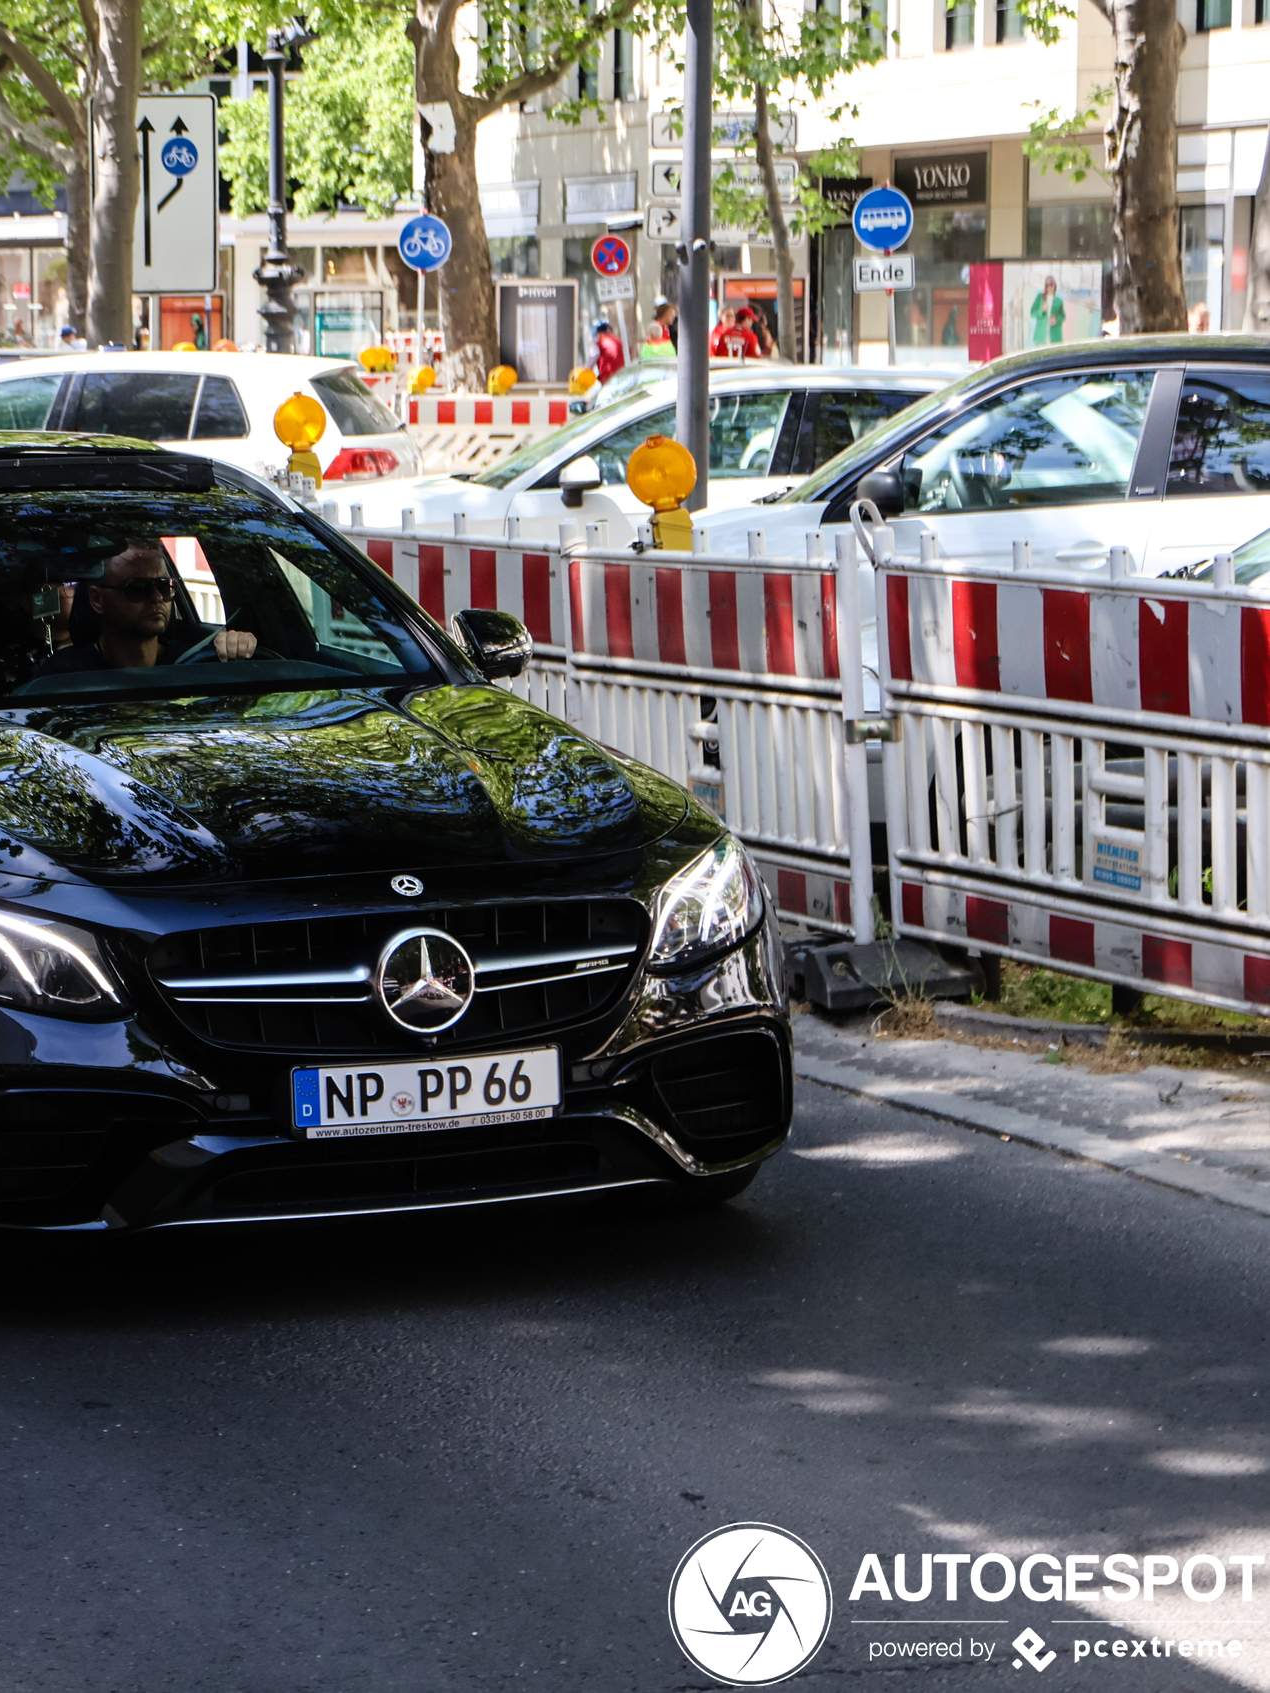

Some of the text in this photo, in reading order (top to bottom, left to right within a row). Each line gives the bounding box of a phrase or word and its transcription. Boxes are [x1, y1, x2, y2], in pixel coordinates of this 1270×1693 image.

[914, 164, 970, 190] YONKO
[859, 263, 904, 282] Ende
[326, 1059, 532, 1119] NP PP 66
[302, 1104, 313, 1117] D
[315, 1119, 460, 1138] www.autozentrum-treskow.de
